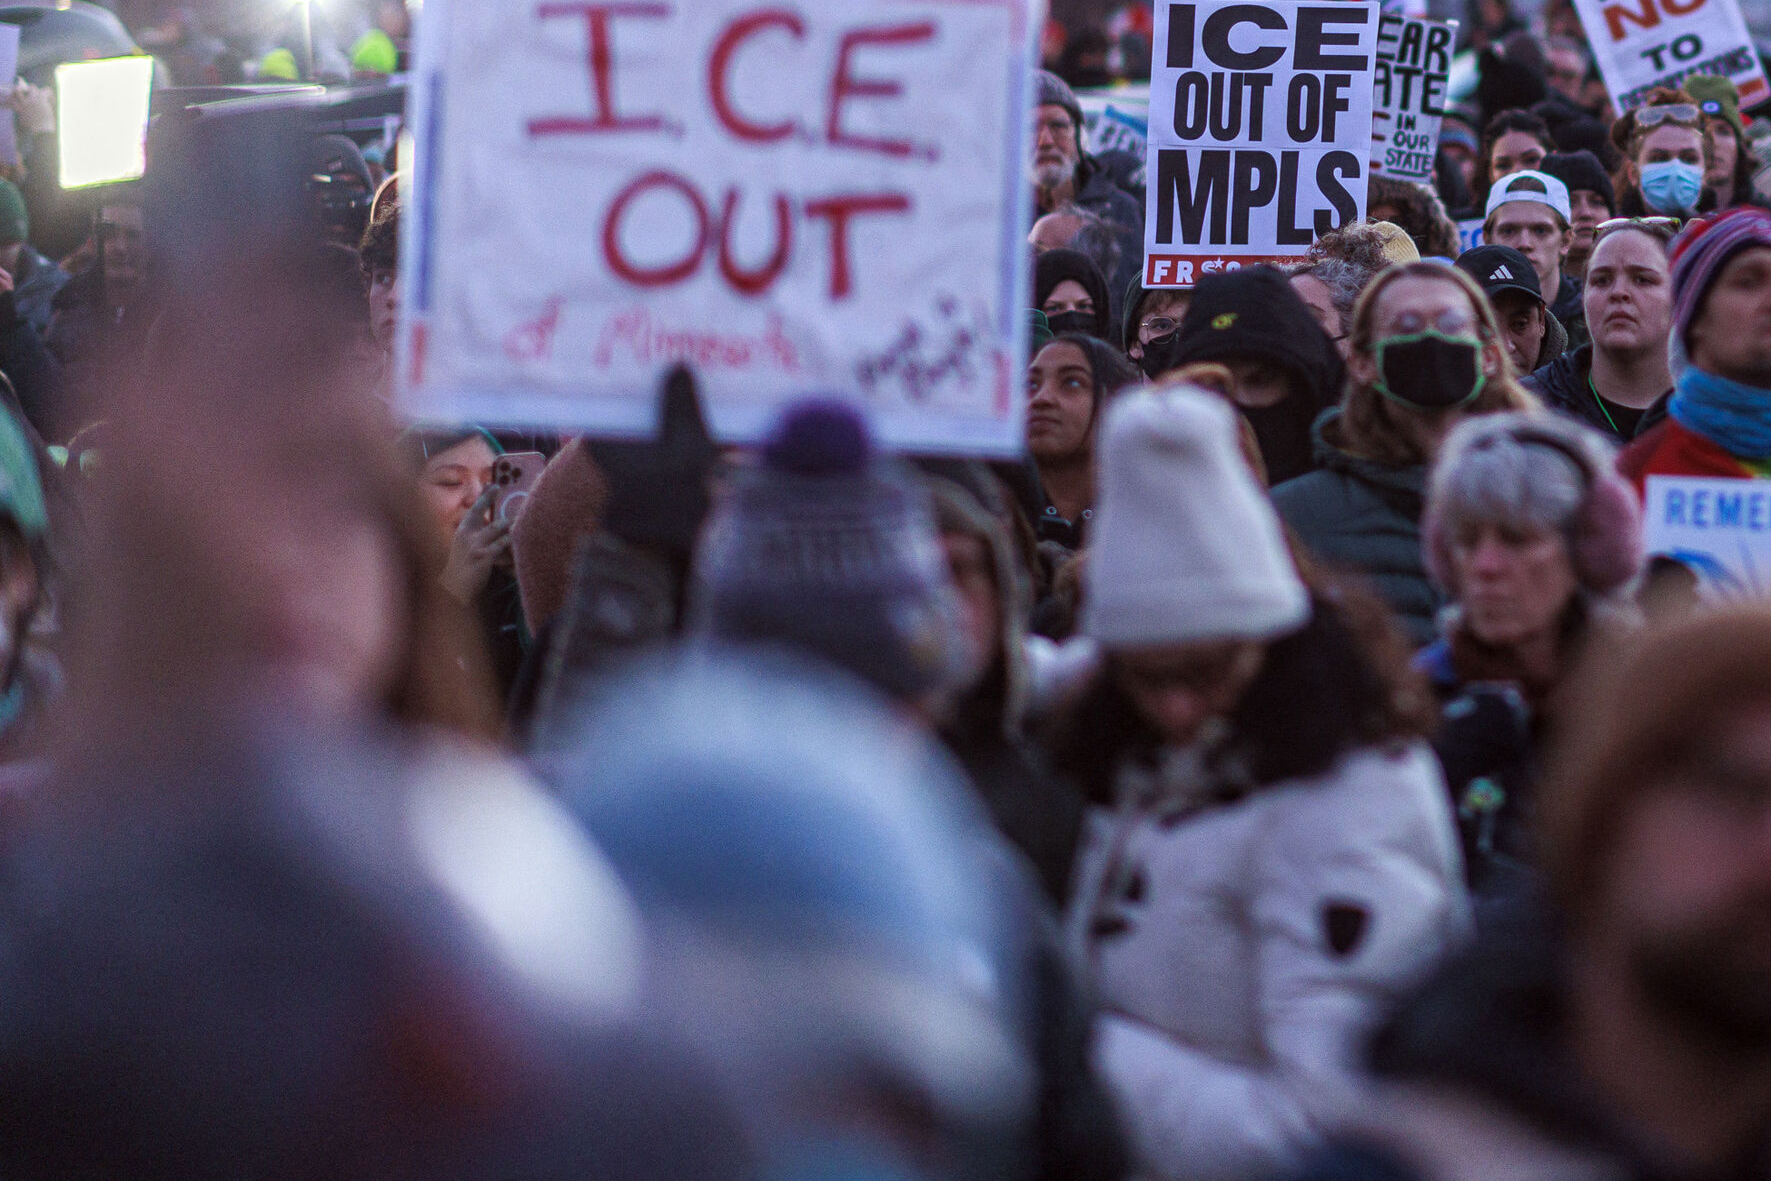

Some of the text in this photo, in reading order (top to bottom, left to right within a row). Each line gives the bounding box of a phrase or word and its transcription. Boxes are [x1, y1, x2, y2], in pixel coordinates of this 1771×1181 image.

[1166, 3, 1370, 71] ICE
[1378, 15, 1451, 73] EAR
[1640, 34, 1703, 71] TO
[1173, 71, 1273, 142] OUT
[1286, 72, 1352, 143] OF
[1375, 60, 1448, 117] ATE
[1393, 130, 1431, 152] OUR
[1396, 113, 1416, 131] IN
[1385, 147, 1433, 172] STATE
[1155, 149, 1361, 246] MPLS
[602, 172, 910, 301] OUT
